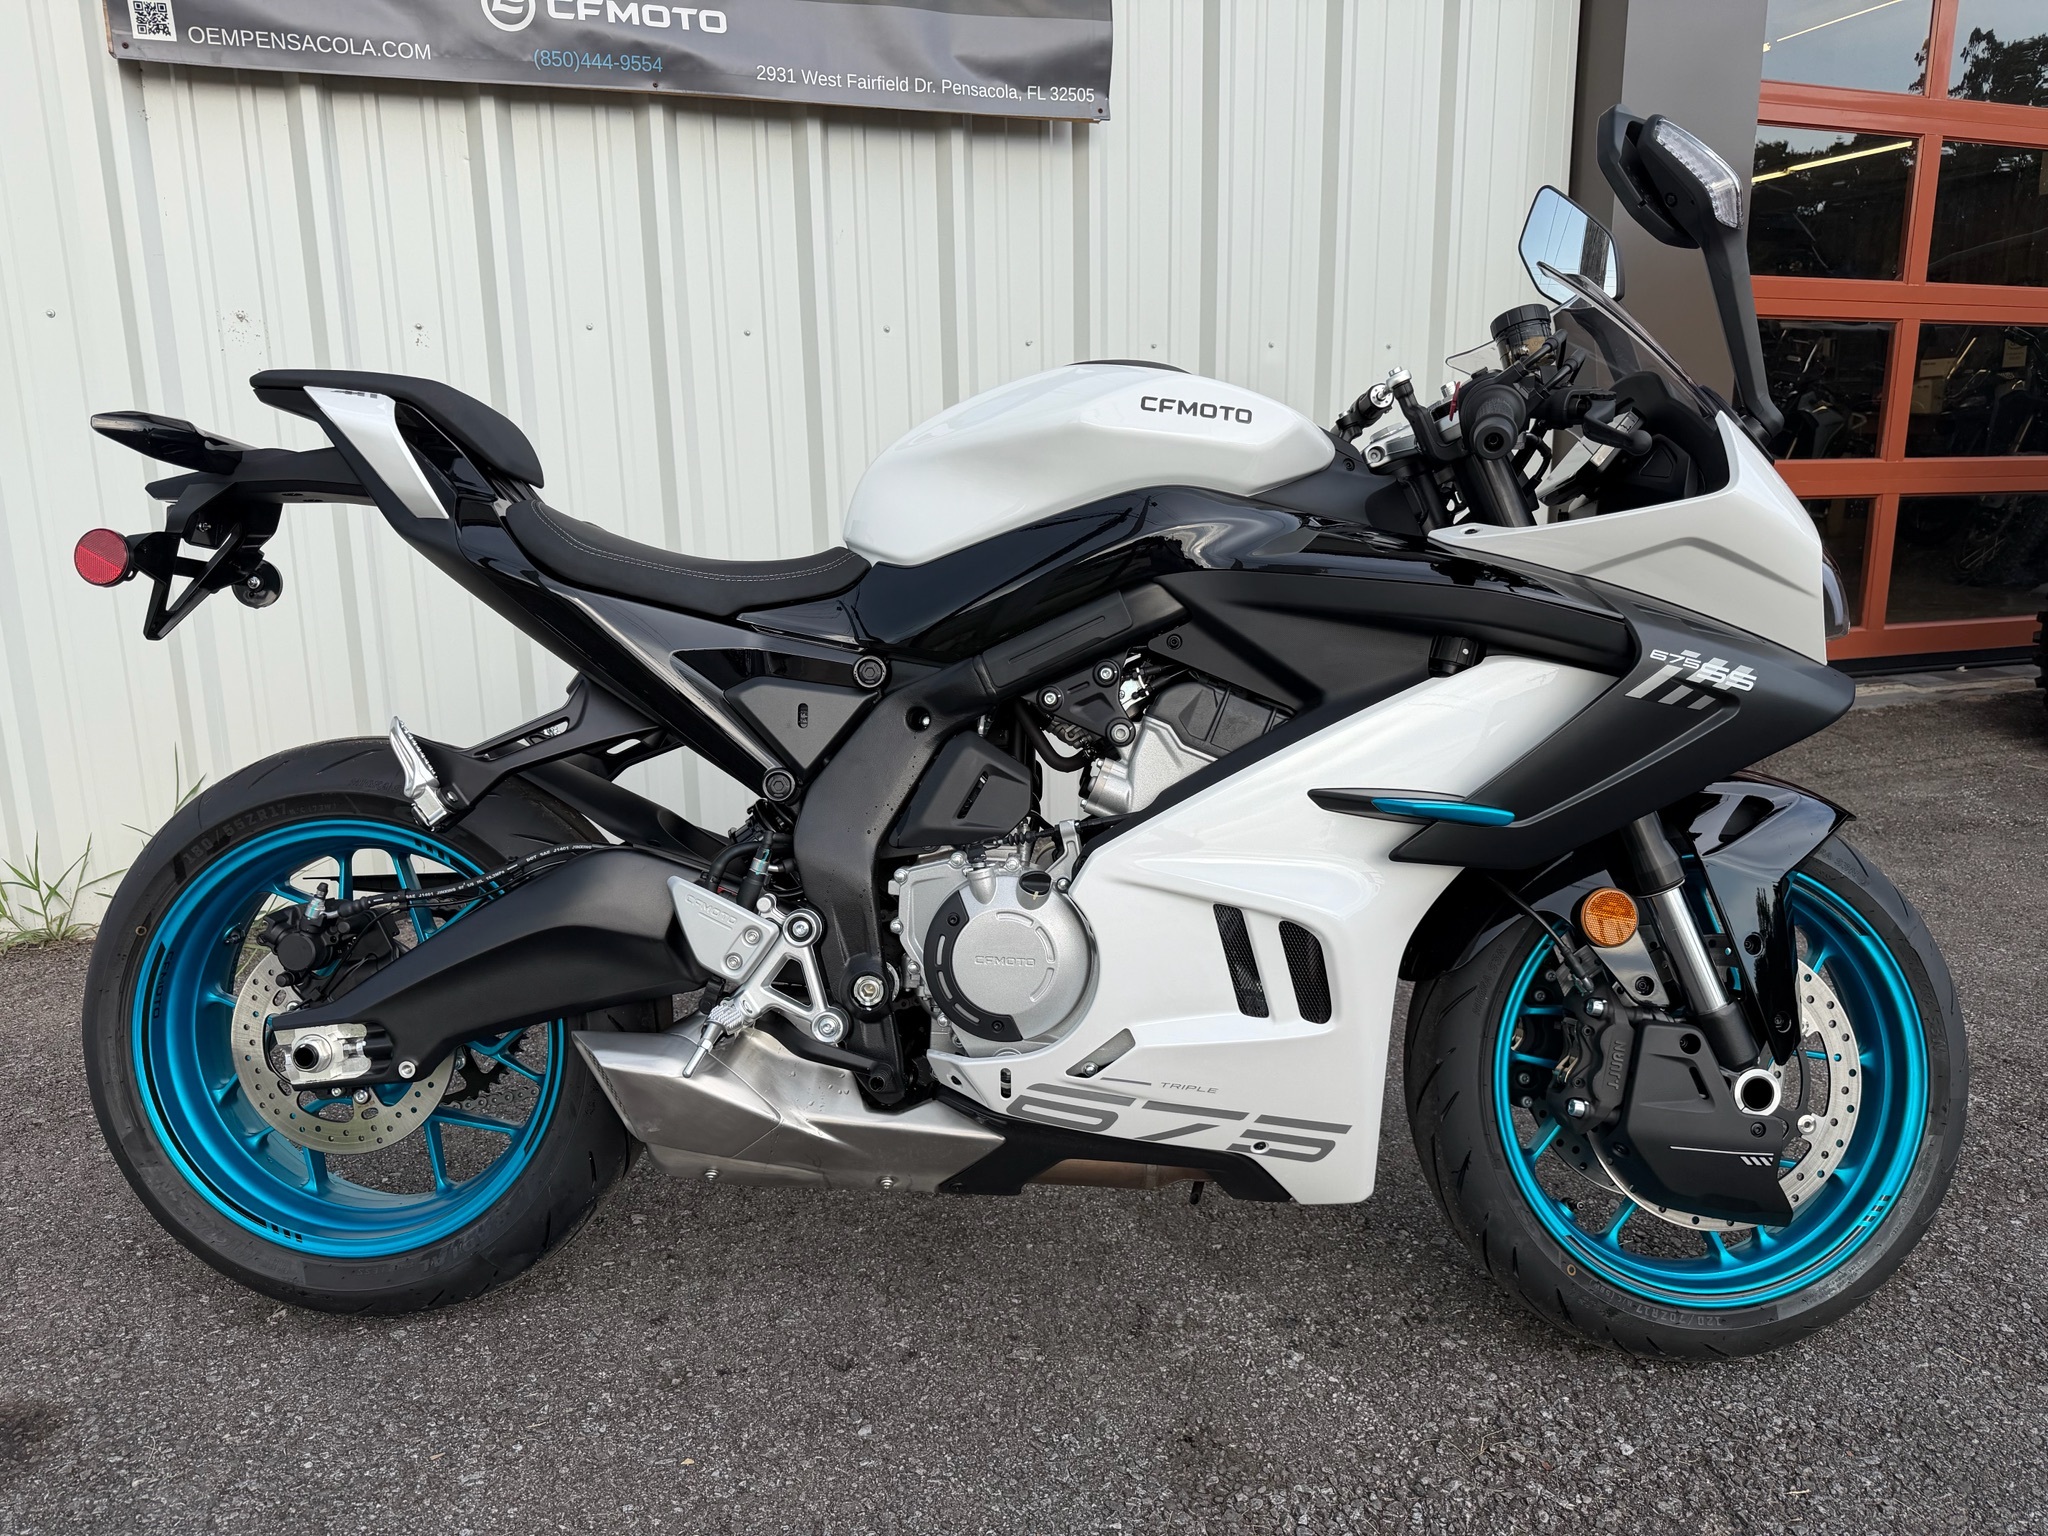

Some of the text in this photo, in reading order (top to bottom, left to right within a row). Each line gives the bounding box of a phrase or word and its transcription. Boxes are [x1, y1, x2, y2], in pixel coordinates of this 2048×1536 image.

[547, 0, 728, 34] CFMOTO
[188, 26, 432, 60] OEMPENSACOLA.COM
[533, 49, 663, 73] (850)444-9554
[756, 65, 1096, 103] 2931 West Fairfield Dr. Pensacola, FL 32505
[1140, 395, 1252, 424] CFMOTO
[684, 894, 738, 925] CFMOTO
[974, 955, 1036, 967] CFMOTO
[153, 951, 174, 1018] CFMOTO
[1160, 1082, 1219, 1094] TRIPLE
[1006, 1083, 1353, 1163] 675
